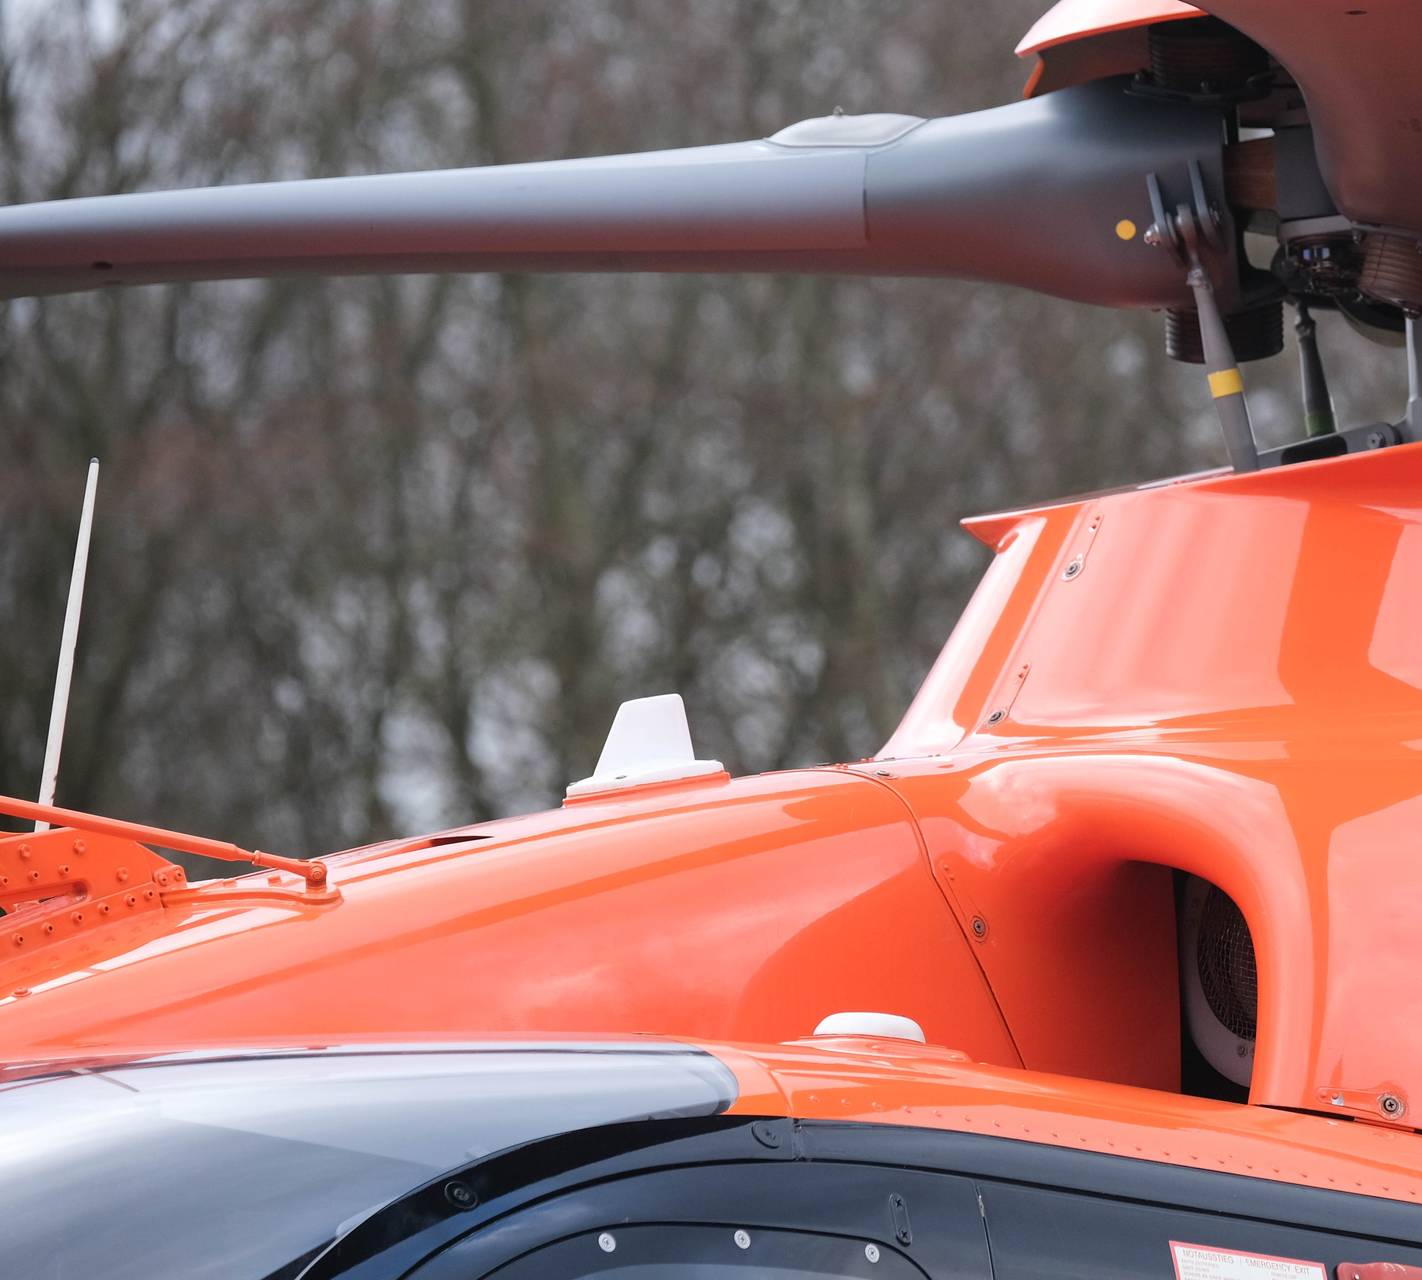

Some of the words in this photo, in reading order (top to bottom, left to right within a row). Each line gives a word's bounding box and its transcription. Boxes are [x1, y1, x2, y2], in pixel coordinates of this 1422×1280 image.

[1182, 1249, 1235, 1265] NOTAUSSTIEG
[1245, 1257, 1291, 1273] EMERGENCY
[1294, 1264, 1310, 1275] EXIT
